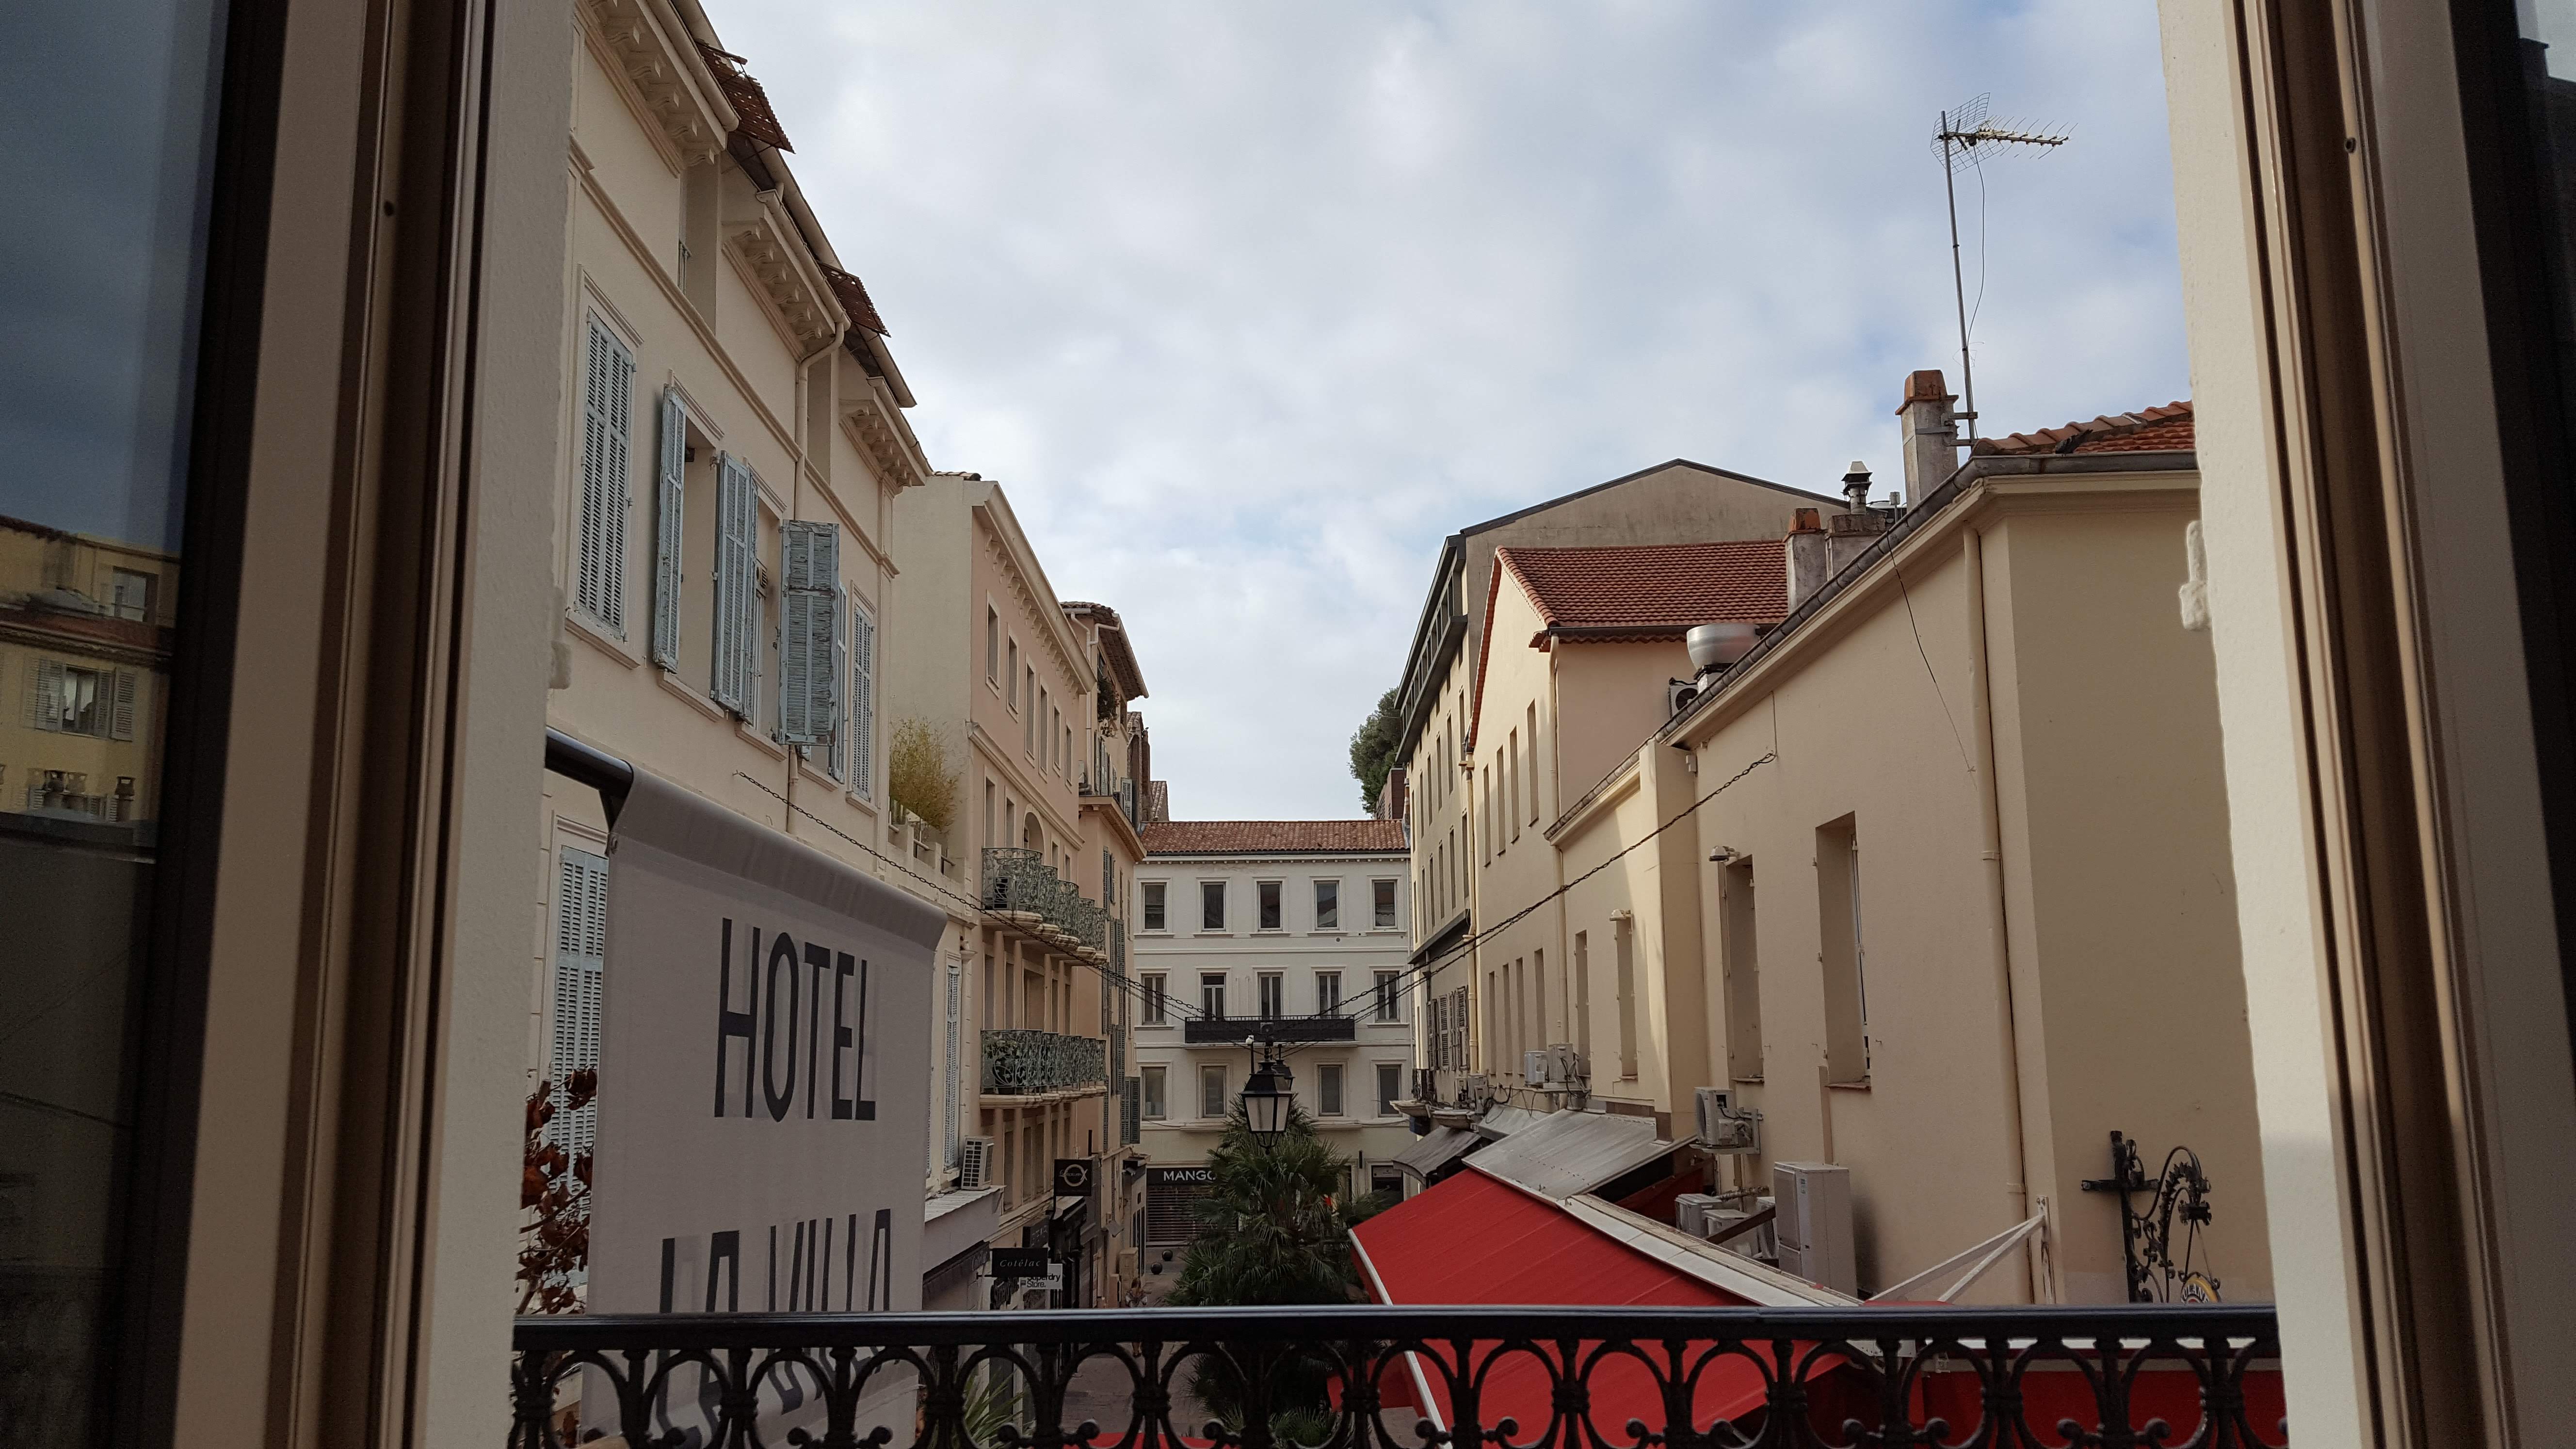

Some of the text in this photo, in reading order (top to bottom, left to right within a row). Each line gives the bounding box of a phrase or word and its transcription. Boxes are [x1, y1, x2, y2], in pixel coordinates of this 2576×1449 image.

[714, 918, 876, 1122] HOTEL
[1164, 1170, 1216, 1181] MANGO
[999, 1258, 1040, 1267] Cotélac
